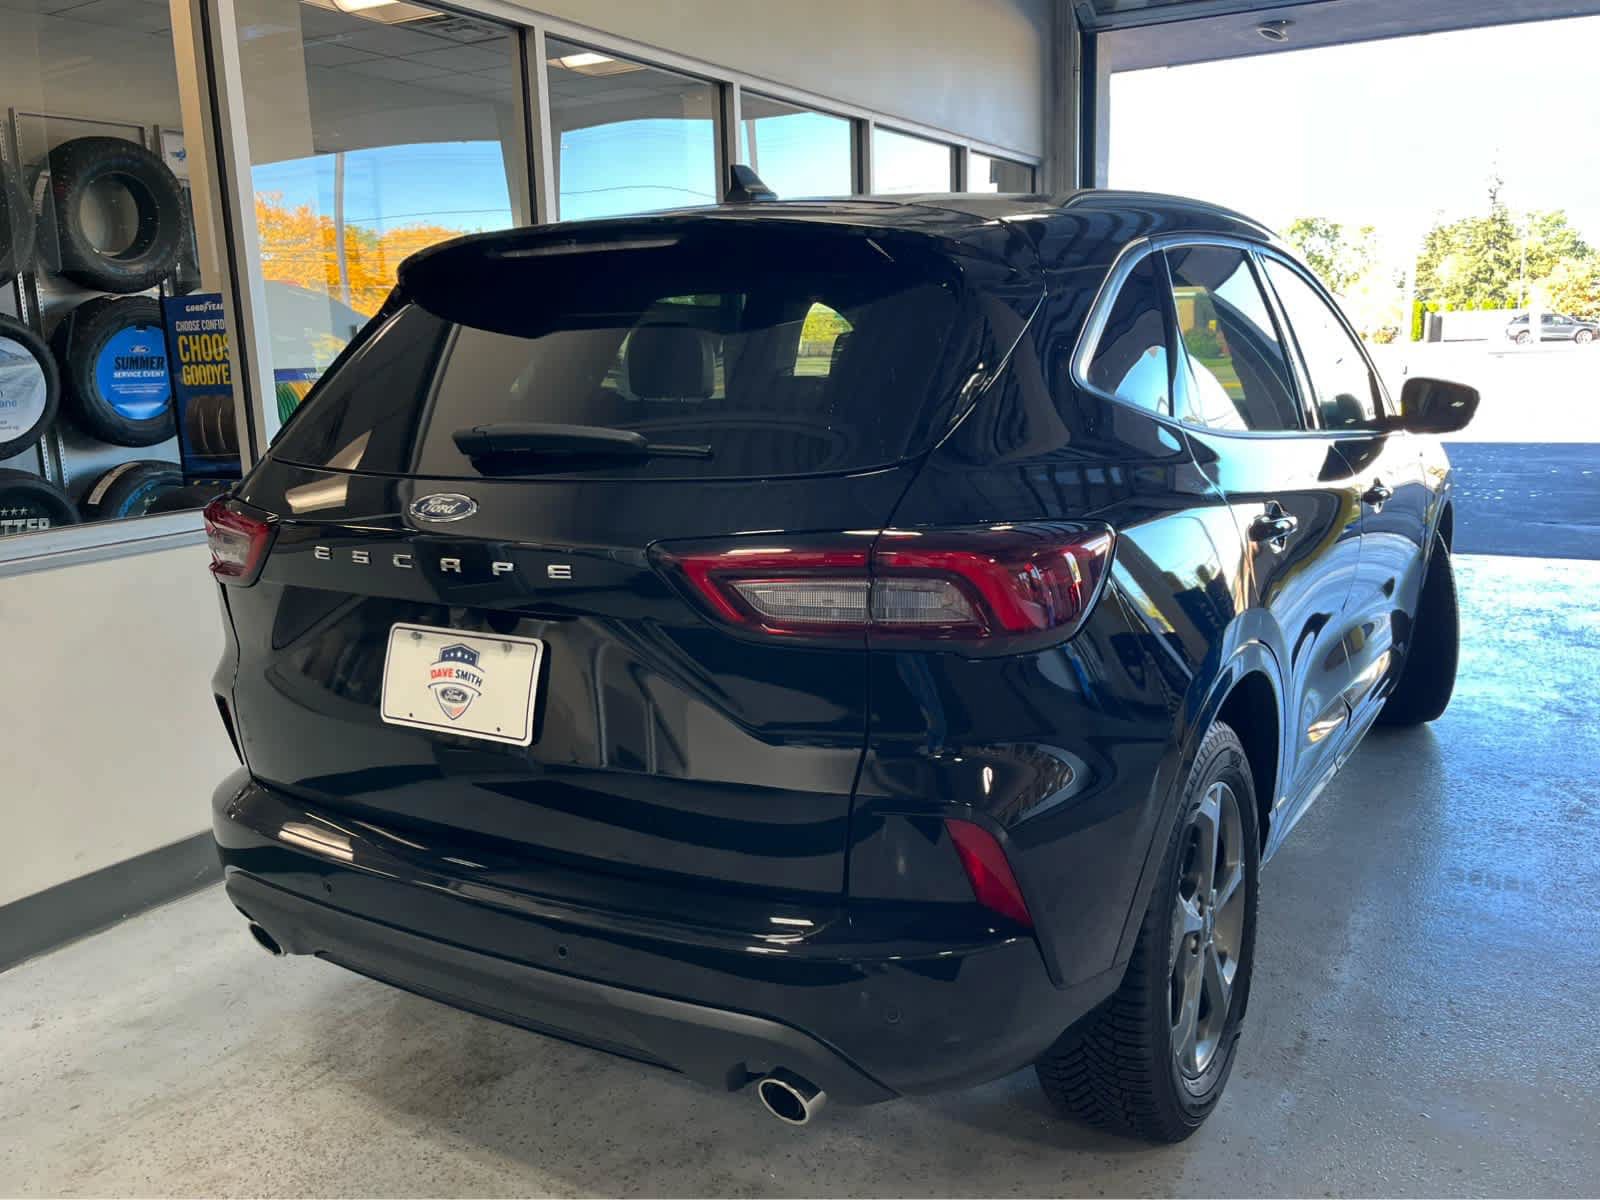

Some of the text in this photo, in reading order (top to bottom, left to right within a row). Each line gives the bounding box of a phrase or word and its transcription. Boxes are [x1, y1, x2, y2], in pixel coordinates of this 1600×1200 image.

[176, 320, 201, 332] CHOOSE
[178, 334, 230, 363] CHOOS
[114, 355, 165, 370] SUMMER
[143, 370, 165, 378] EVENT
[314, 545, 573, 580] ESCAPE
[430, 667, 483, 687] DAVE SMITH
